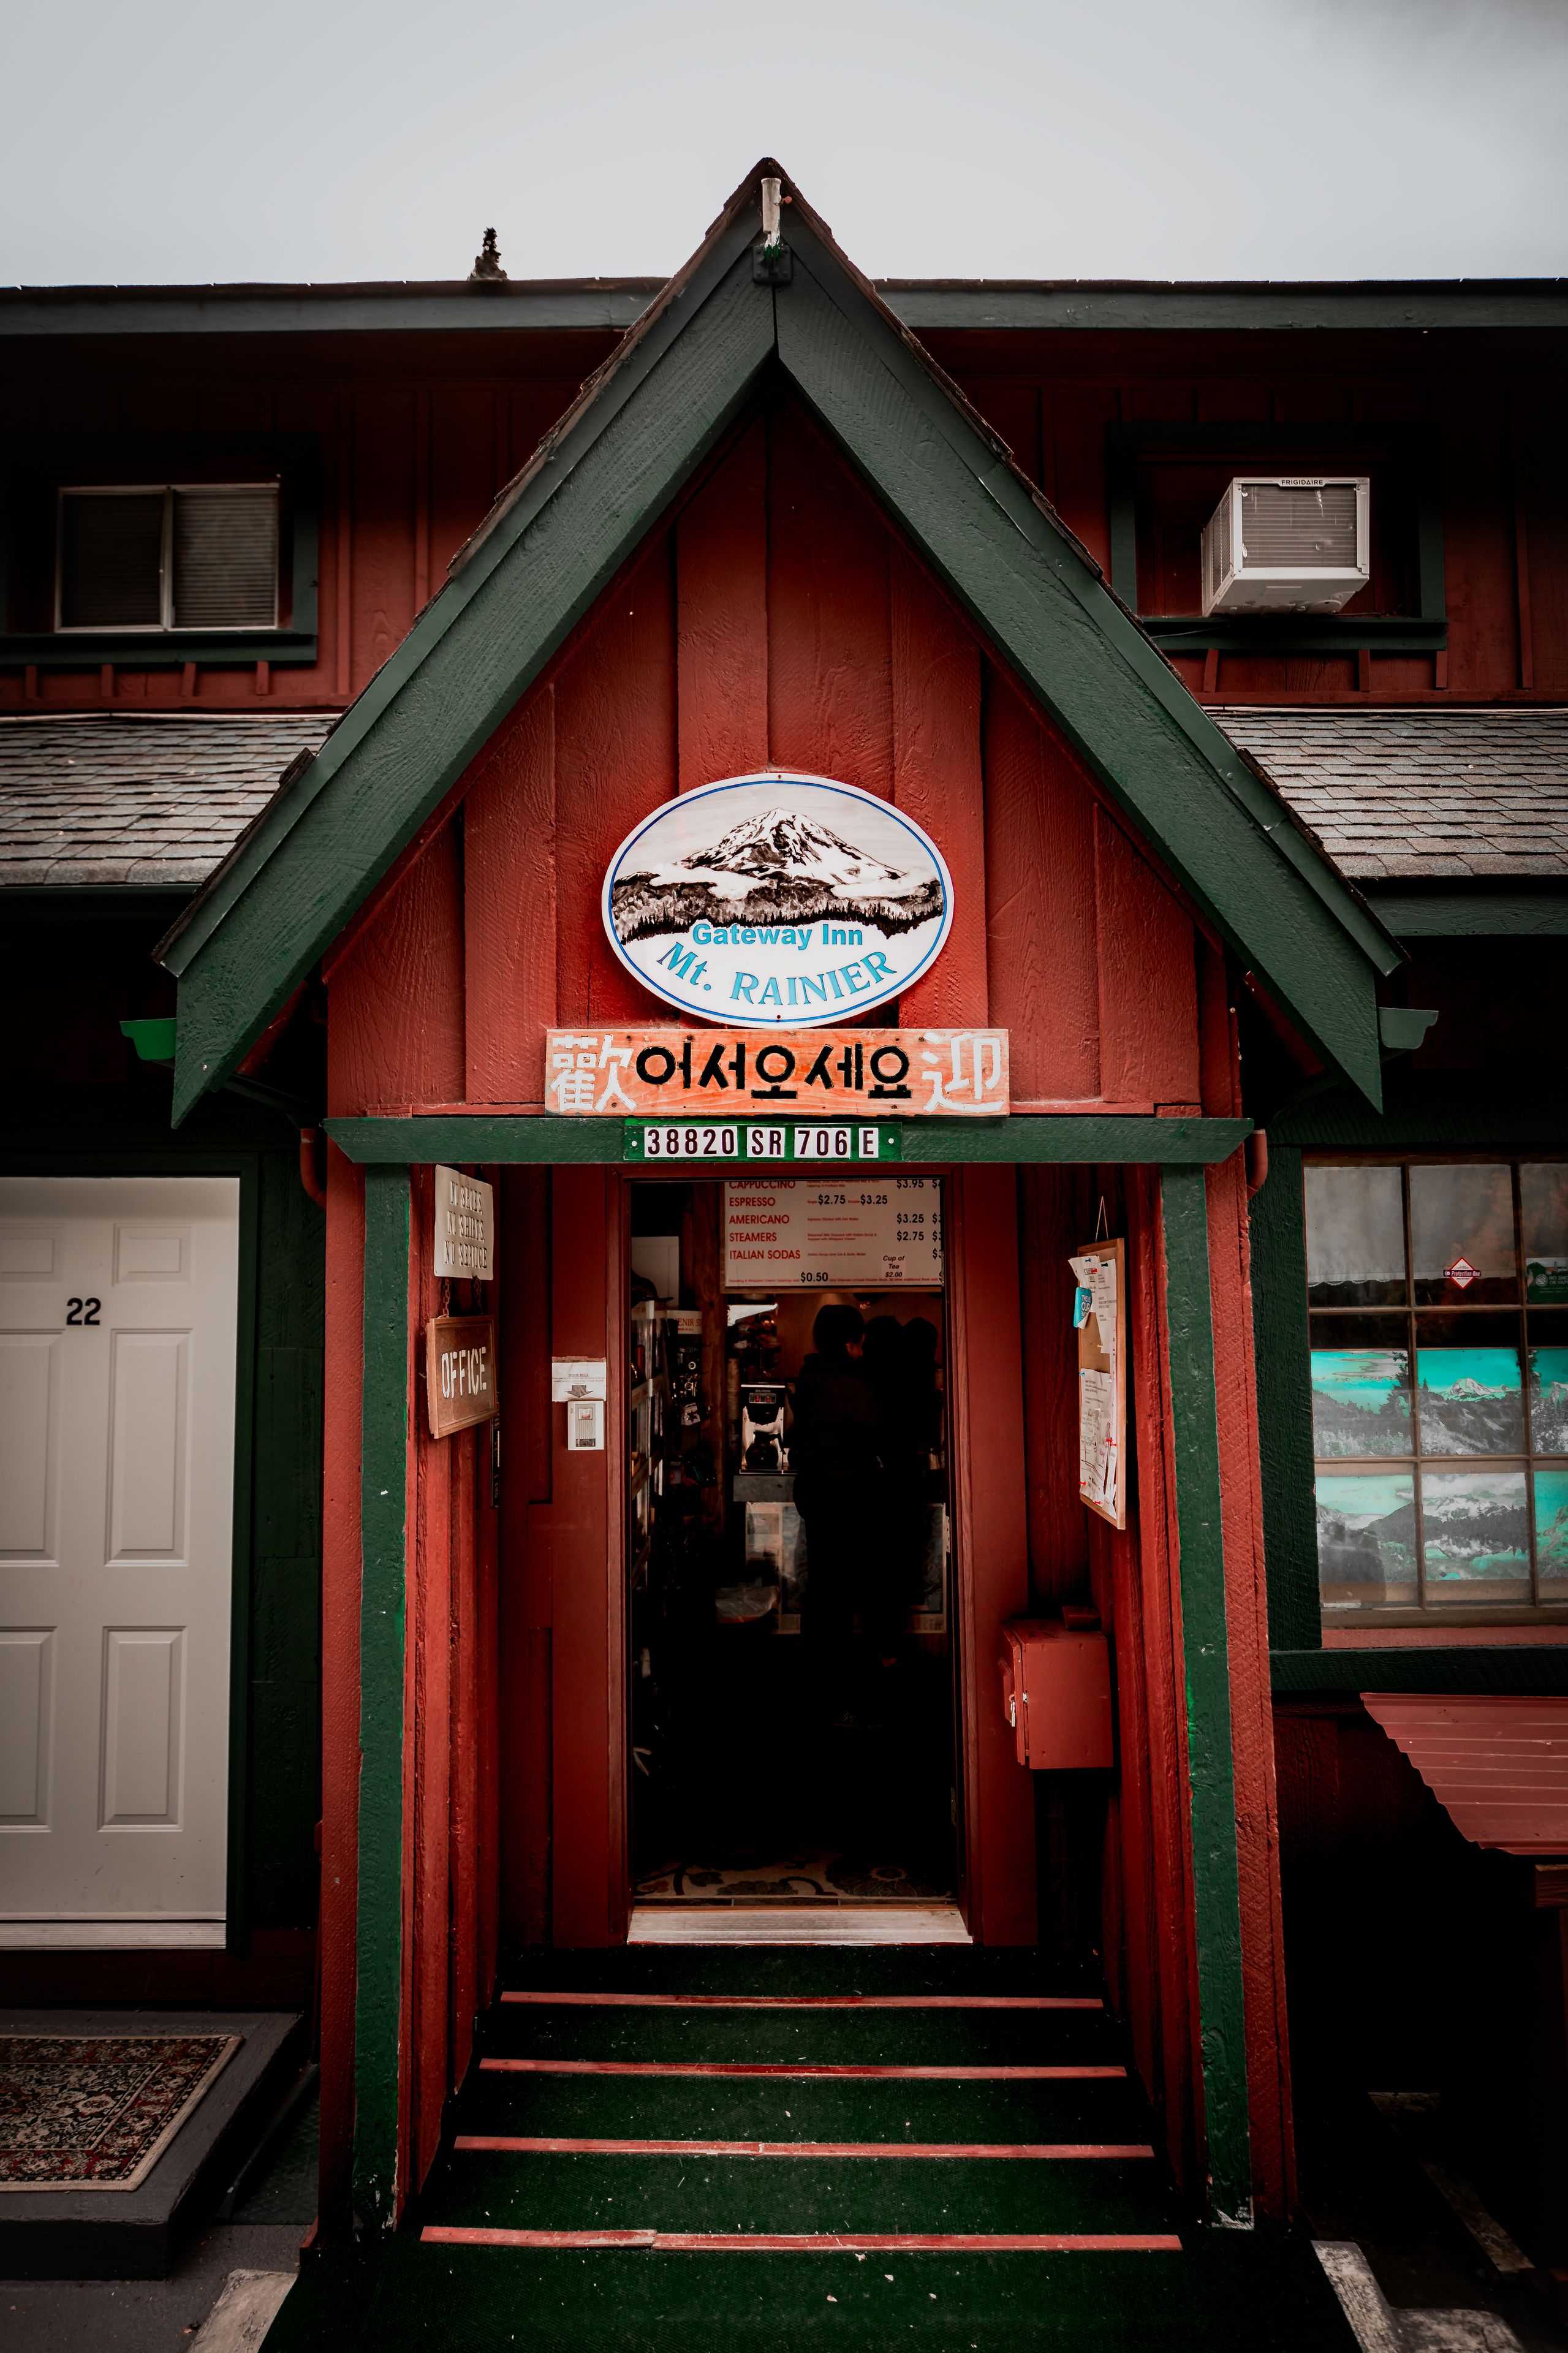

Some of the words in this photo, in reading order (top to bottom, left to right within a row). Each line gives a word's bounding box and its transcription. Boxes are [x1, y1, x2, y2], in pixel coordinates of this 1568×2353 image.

[692, 923, 812, 950] Gateway
[822, 923, 863, 945] Inn
[656, 941, 711, 991] Mt.
[729, 951, 897, 1006] RAINIER
[635, 1041, 912, 1099] 어서오세요
[921, 1031, 1005, 1113] 迎
[647, 1129, 735, 1155] 38820
[751, 1129, 782, 1156] SR
[797, 1129, 848, 1156] 706
[863, 1129, 874, 1155] E
[729, 1181, 796, 1189] CAPPUCCINO
[896, 1180, 924, 1189] $3.95
[729, 1197, 776, 1207] ESPRESSO
[818, 1194, 846, 1206] $2.75
[860, 1194, 888, 1206] $3.25
[729, 1214, 790, 1224] AMERICANO
[896, 1213, 924, 1224] $3.25
[729, 1232, 778, 1242] STEAMERS
[896, 1230, 924, 1242] $2.75
[460, 1243, 488, 1269] SERVICE
[729, 1249, 765, 1260] ITALIAN
[767, 1249, 801, 1259] SODAS
[800, 1271, 828, 1283] $0.50
[66, 1297, 101, 1325] 22
[441, 1346, 487, 1399] OFFICE
